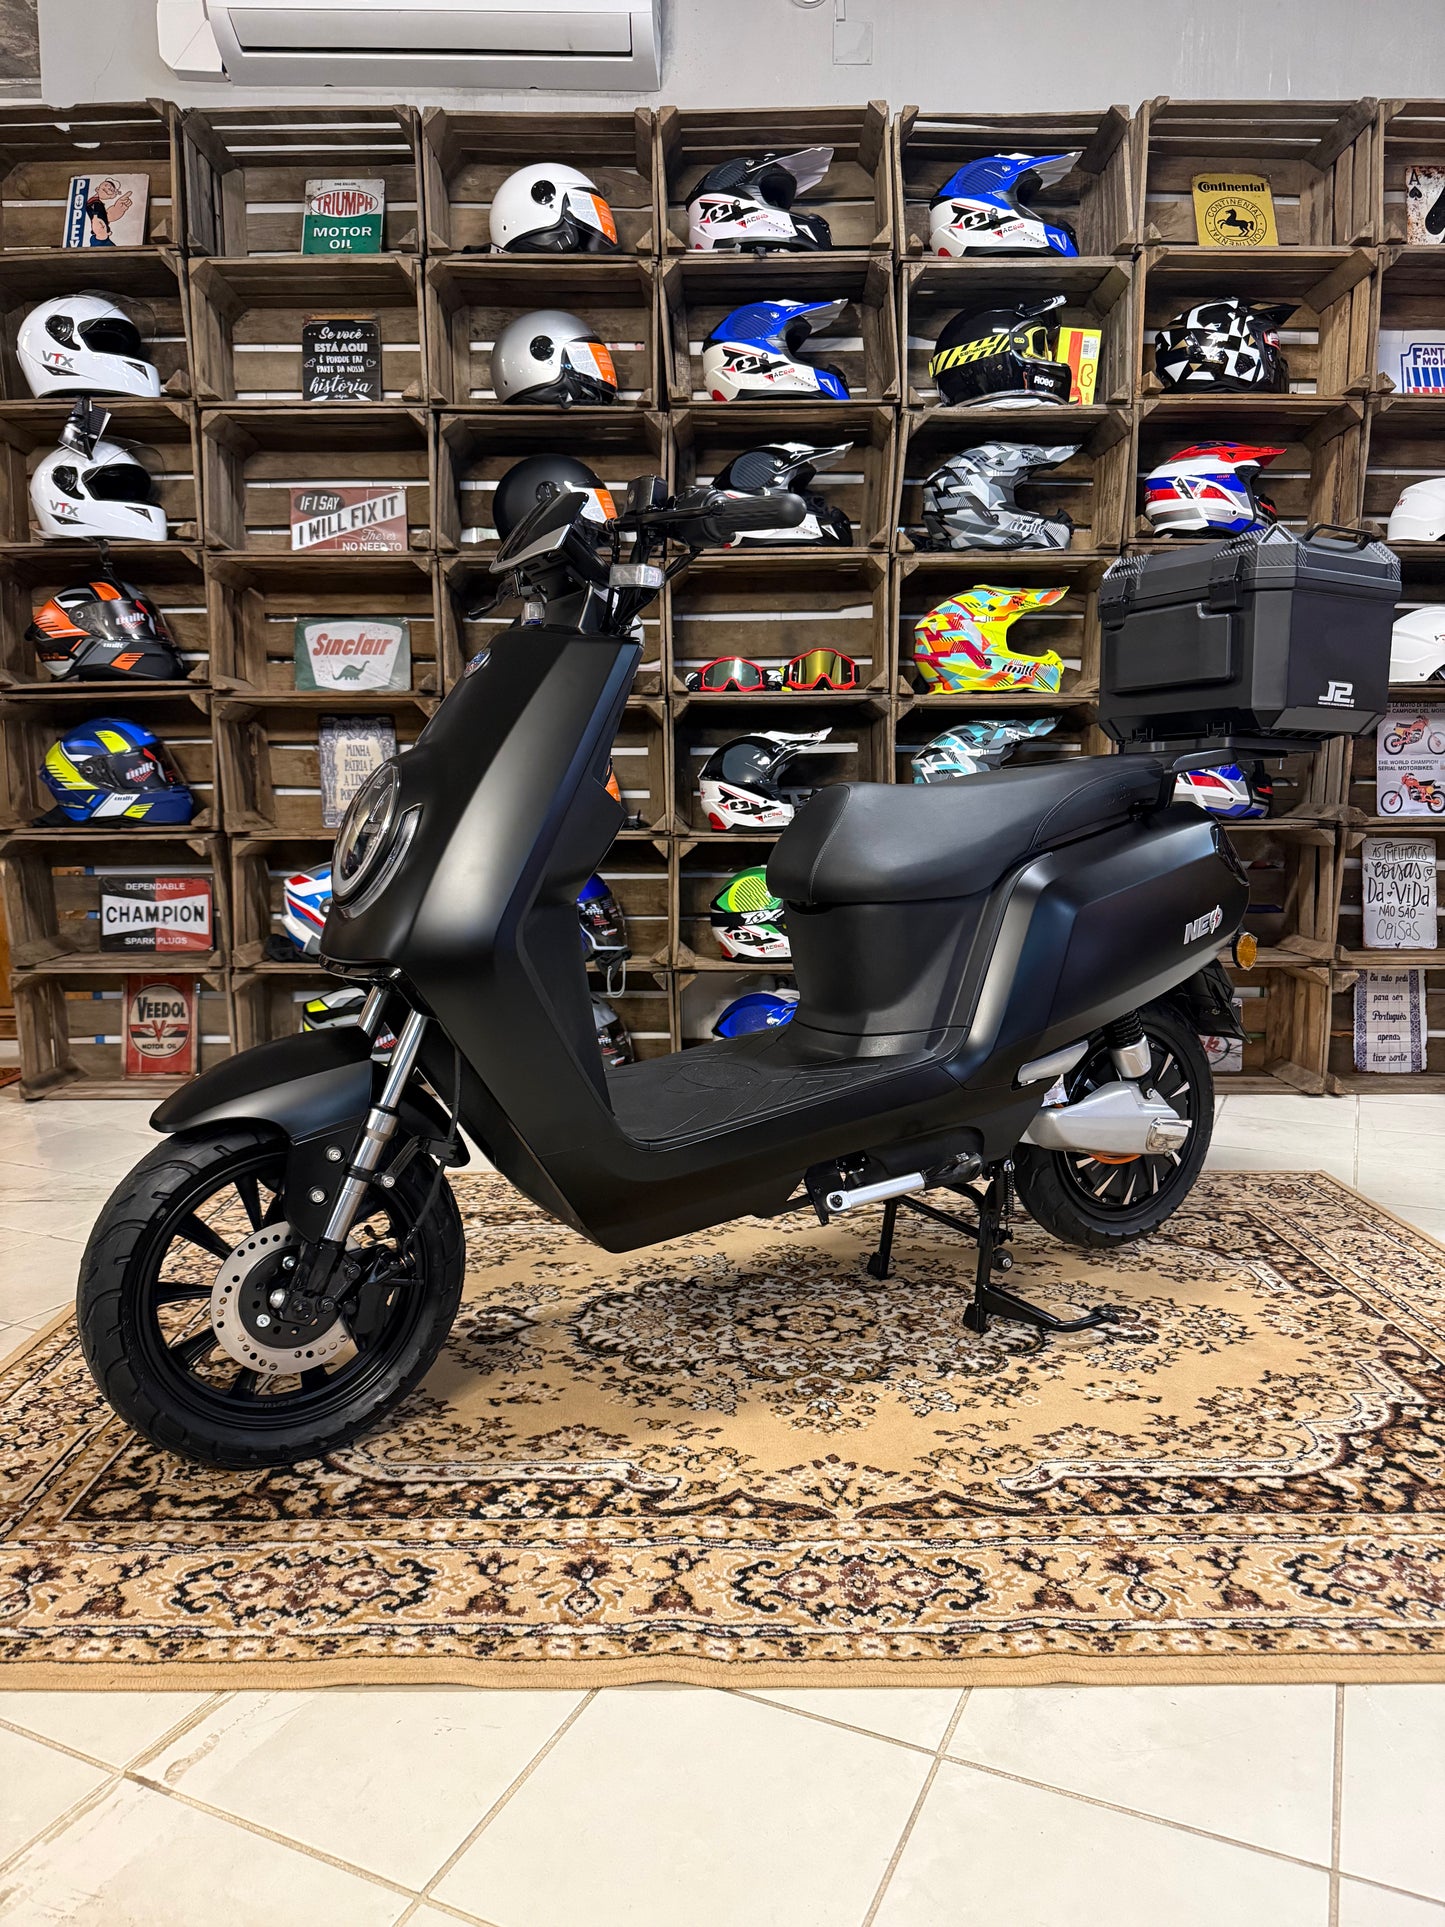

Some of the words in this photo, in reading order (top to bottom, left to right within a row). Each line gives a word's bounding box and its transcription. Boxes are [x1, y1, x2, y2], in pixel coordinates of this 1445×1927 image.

[1408, 169, 1421, 185] A
[1198, 181, 1265, 193] Continental
[316, 191, 373, 216] TRIUMPH
[1208, 198, 1262, 219] CONTINENTAL
[313, 226, 372, 237] MOTOR
[329, 239, 353, 249] OIL
[319, 327, 335, 339] Se
[336, 328, 363, 339] você
[314, 341, 339, 352] ESTÁ
[340, 343, 368, 352] AQUI
[42, 350, 74, 368] VTX
[326, 356, 350, 364] PORQUE
[316, 365, 334, 373] PARTE
[347, 365, 365, 373] NOSSA
[309, 374, 373, 394] história
[50, 499, 79, 517] VTX
[300, 496, 312, 510] IF
[313, 496, 319, 510] I
[319, 496, 340, 510] SAY
[299, 525, 304, 545] I
[308, 513, 347, 541] WILL
[350, 501, 377, 528] FIX
[382, 495, 398, 518] IT
[342, 542, 357, 551] NO
[312, 633, 394, 656] Sinclair
[346, 744, 371, 756] MINHA
[343, 774, 350, 786] A
[1372, 846, 1381, 858] AS
[1387, 845, 1428, 861] MELHORES
[125, 883, 186, 891] DEPENDABLE
[106, 905, 204, 923] CHAMPION
[1379, 902, 1395, 917] NÃO
[1398, 904, 1416, 919] SÃO
[124, 937, 155, 945] SPARK
[157, 937, 188, 945] PLUGS
[137, 996, 186, 1022] VEEDOL
[1373, 1010, 1407, 1023] Português
[1378, 1034, 1400, 1043] apenas
[1373, 1053, 1386, 1062] tive
[1389, 1053, 1407, 1062] sorte
